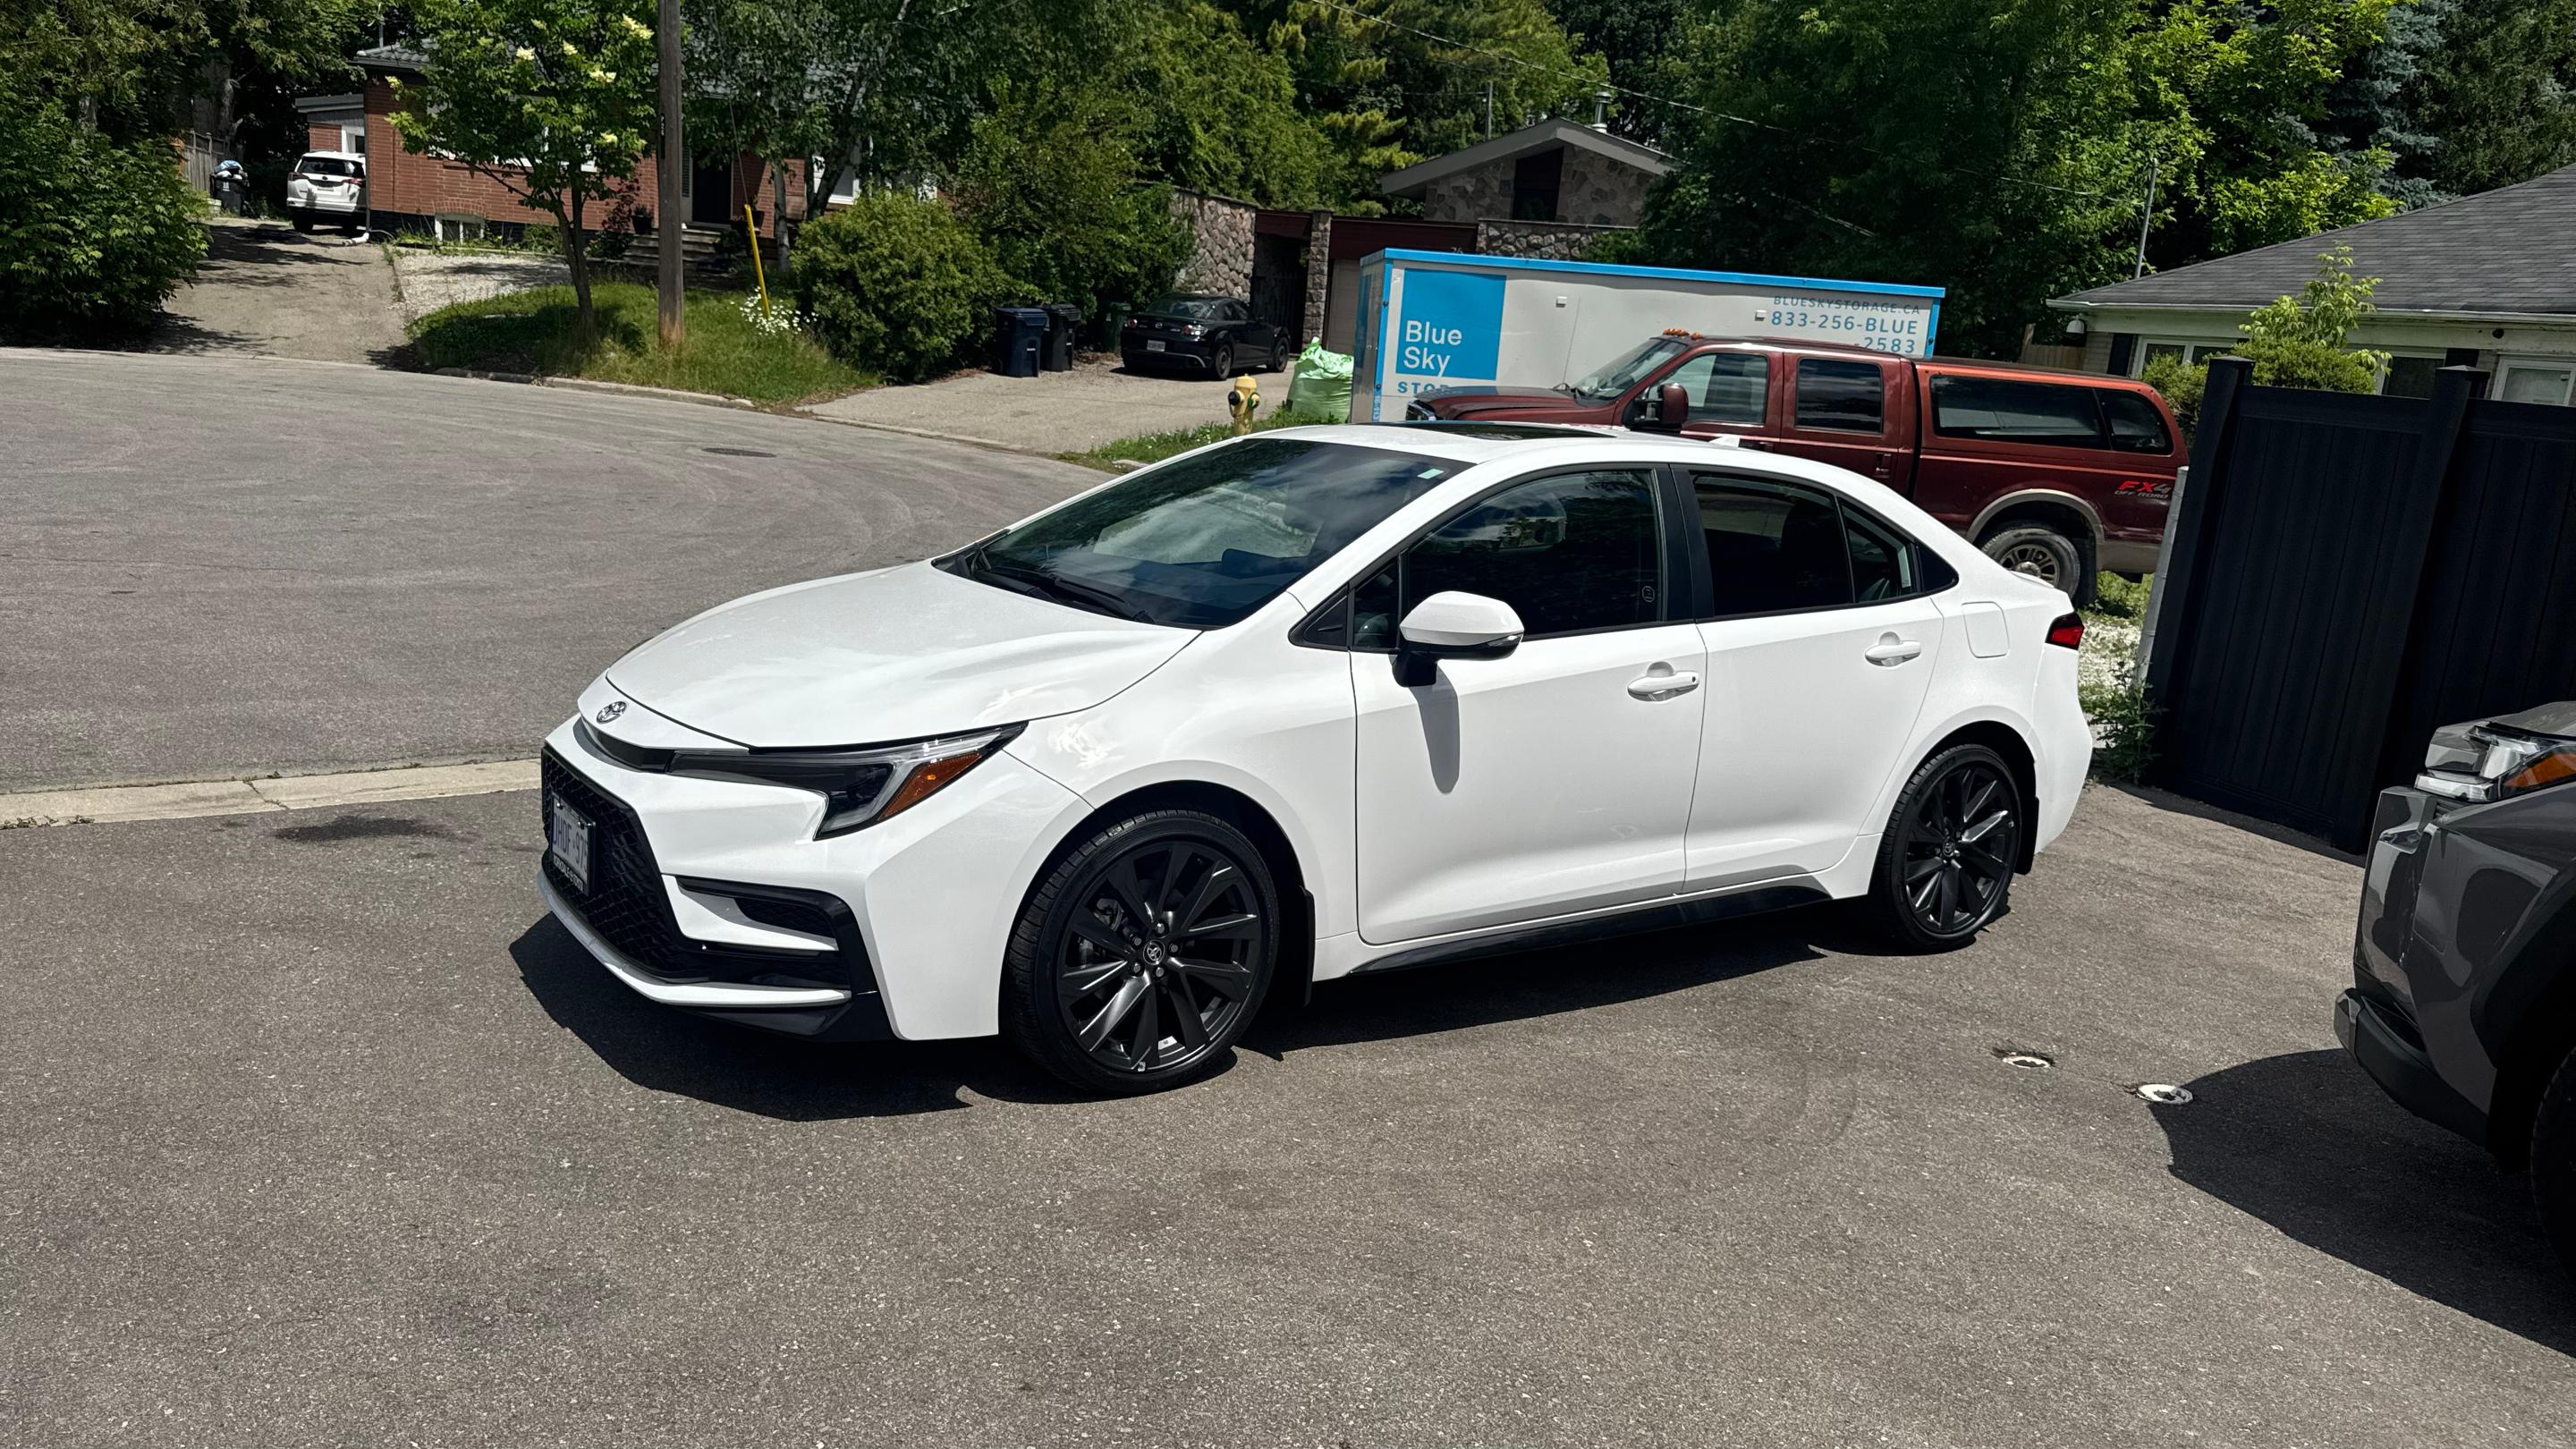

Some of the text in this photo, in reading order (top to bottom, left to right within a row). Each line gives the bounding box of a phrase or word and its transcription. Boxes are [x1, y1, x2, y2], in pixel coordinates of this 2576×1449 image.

[1774, 296, 1919, 314] BLUESKYSTORAGE.CA
[1405, 320, 1462, 346] Blue
[1771, 310, 1919, 335] 833-256-BLUE
[1403, 346, 1451, 377] Sky
[2118, 481, 2171, 494] FX4
